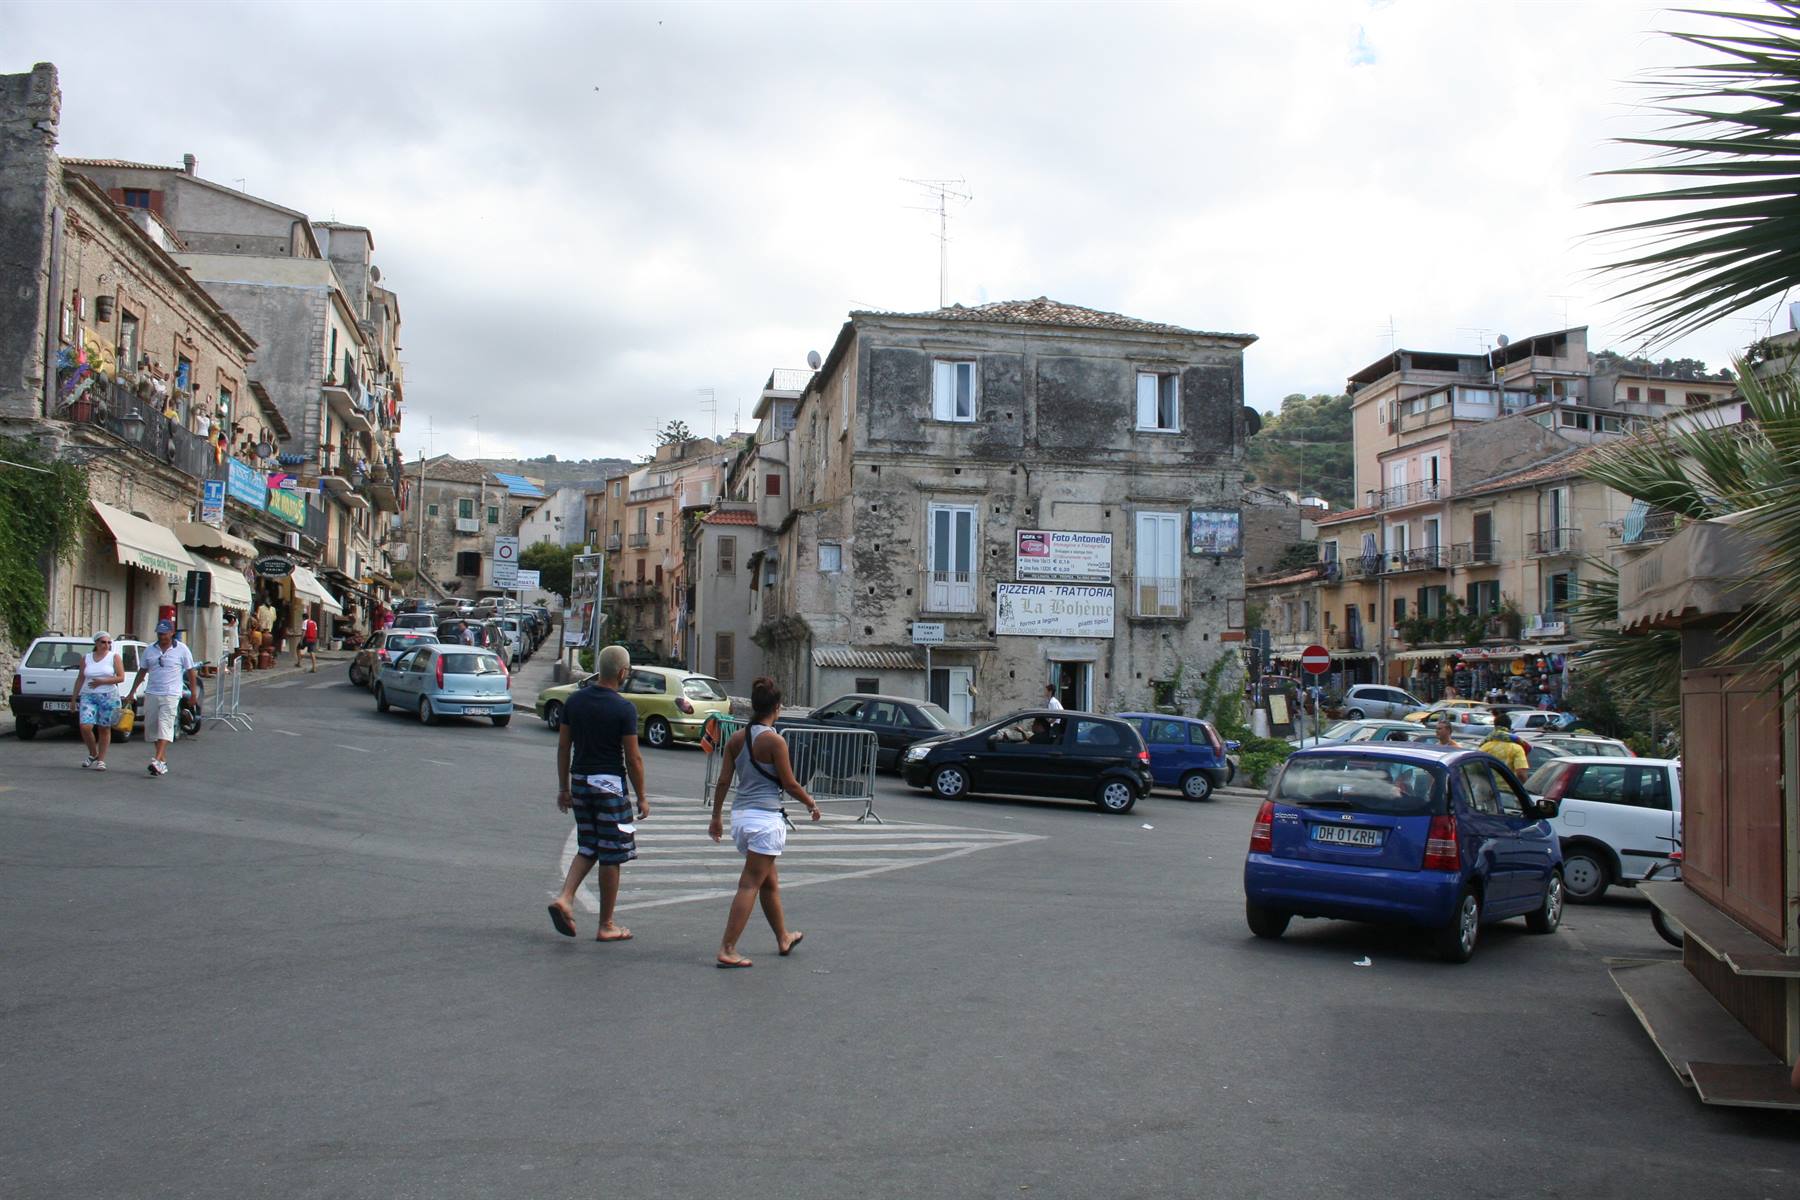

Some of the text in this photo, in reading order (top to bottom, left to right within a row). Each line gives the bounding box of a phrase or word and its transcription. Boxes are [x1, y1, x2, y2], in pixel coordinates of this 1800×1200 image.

[1052, 533, 1110, 543] Foto Antonello
[999, 584, 1113, 597] PIZZERIA TRATTORIA
[1020, 597, 1112, 617] La Bohème
[1319, 827, 1375, 844] DH 014RH
